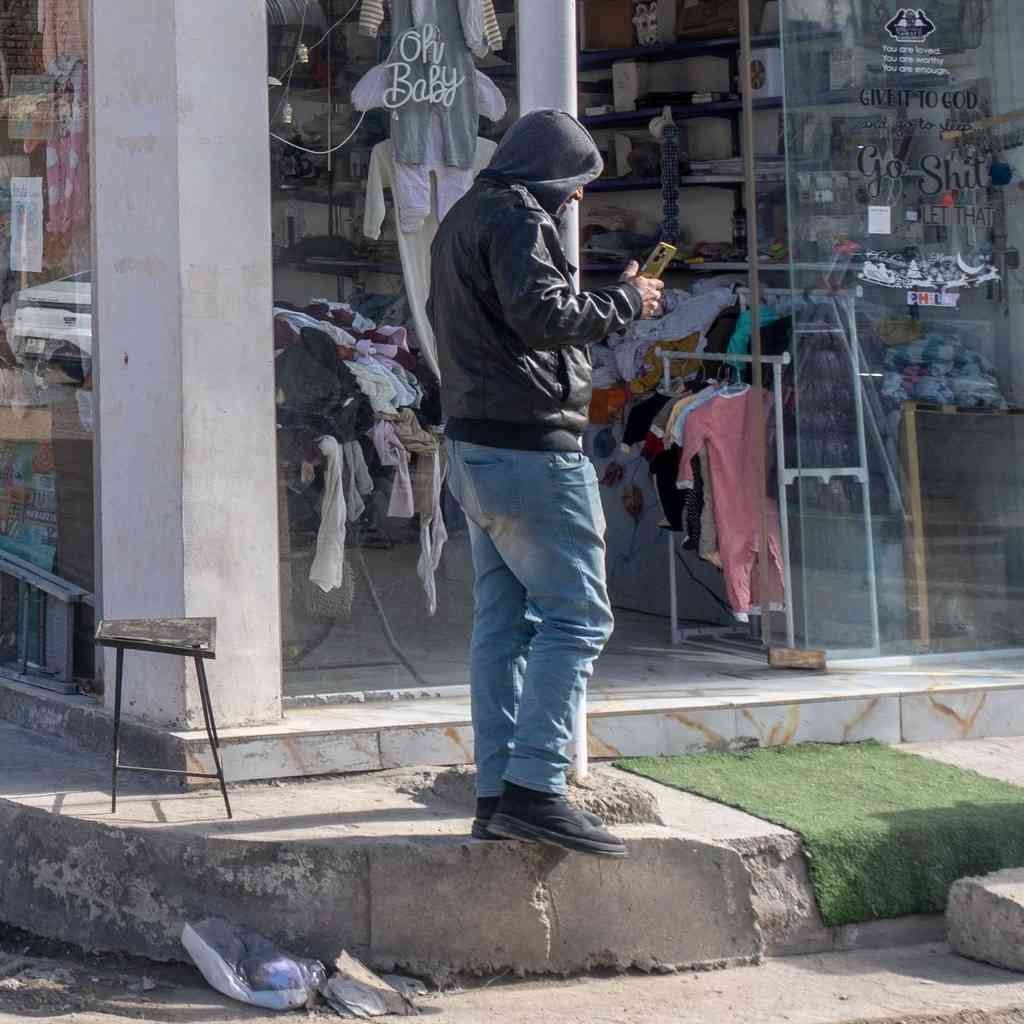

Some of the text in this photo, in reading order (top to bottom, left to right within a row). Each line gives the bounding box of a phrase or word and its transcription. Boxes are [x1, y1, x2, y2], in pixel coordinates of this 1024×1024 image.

[400, 23, 445, 64] Oh
[882, 45, 897, 53] You
[899, 46, 914, 54] are
[882, 55, 897, 63] You
[882, 64, 897, 72] You
[383, 62, 465, 108] Baby
[860, 88, 978, 109] GIVE IT TO GOD
[918, 153, 986, 196] Shit
